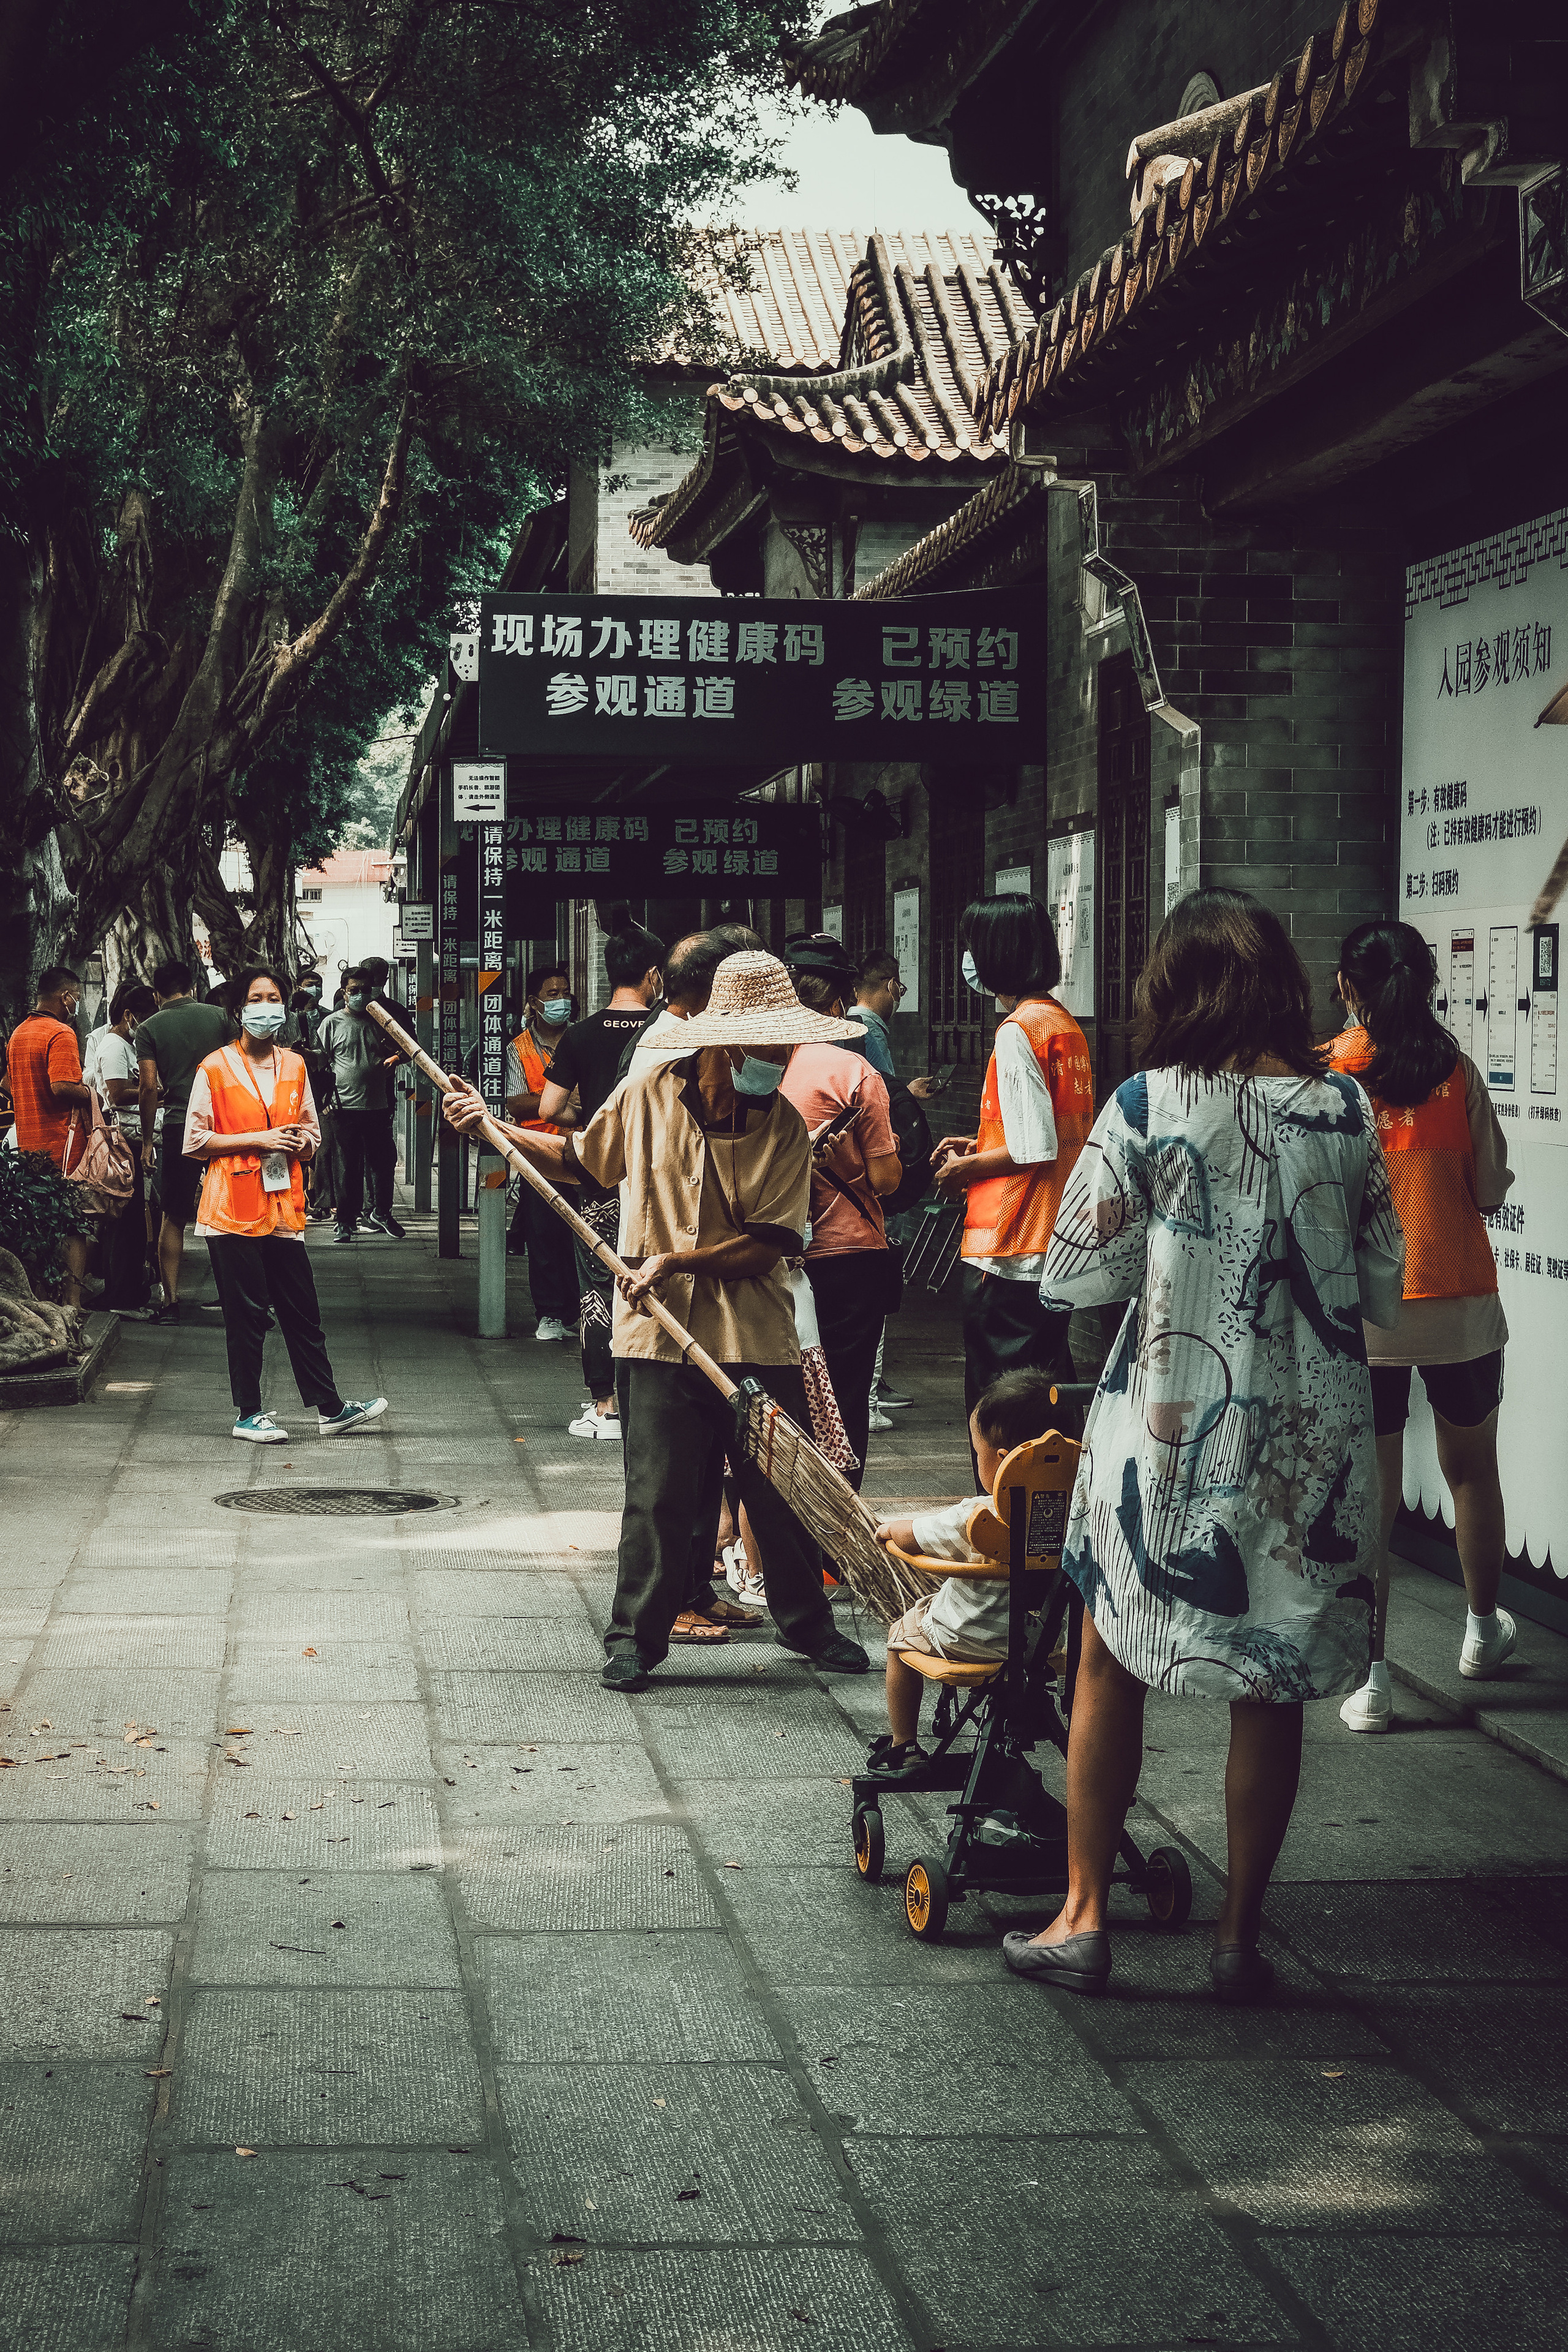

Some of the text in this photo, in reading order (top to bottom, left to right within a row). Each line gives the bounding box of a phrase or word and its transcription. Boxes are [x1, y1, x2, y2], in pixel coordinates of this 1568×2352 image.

[491, 614, 824, 665] 现场办理健康码
[882, 627, 1019, 669] 已预约
[546, 673, 736, 719] 参观通道
[832, 678, 1019, 722] 参观绿道
[674, 818, 758, 845] 已预约
[663, 848, 779, 876] 参观绿道
[483, 826, 503, 972] 请保持一米距离
[443, 874, 458, 984] 请保持一米距离
